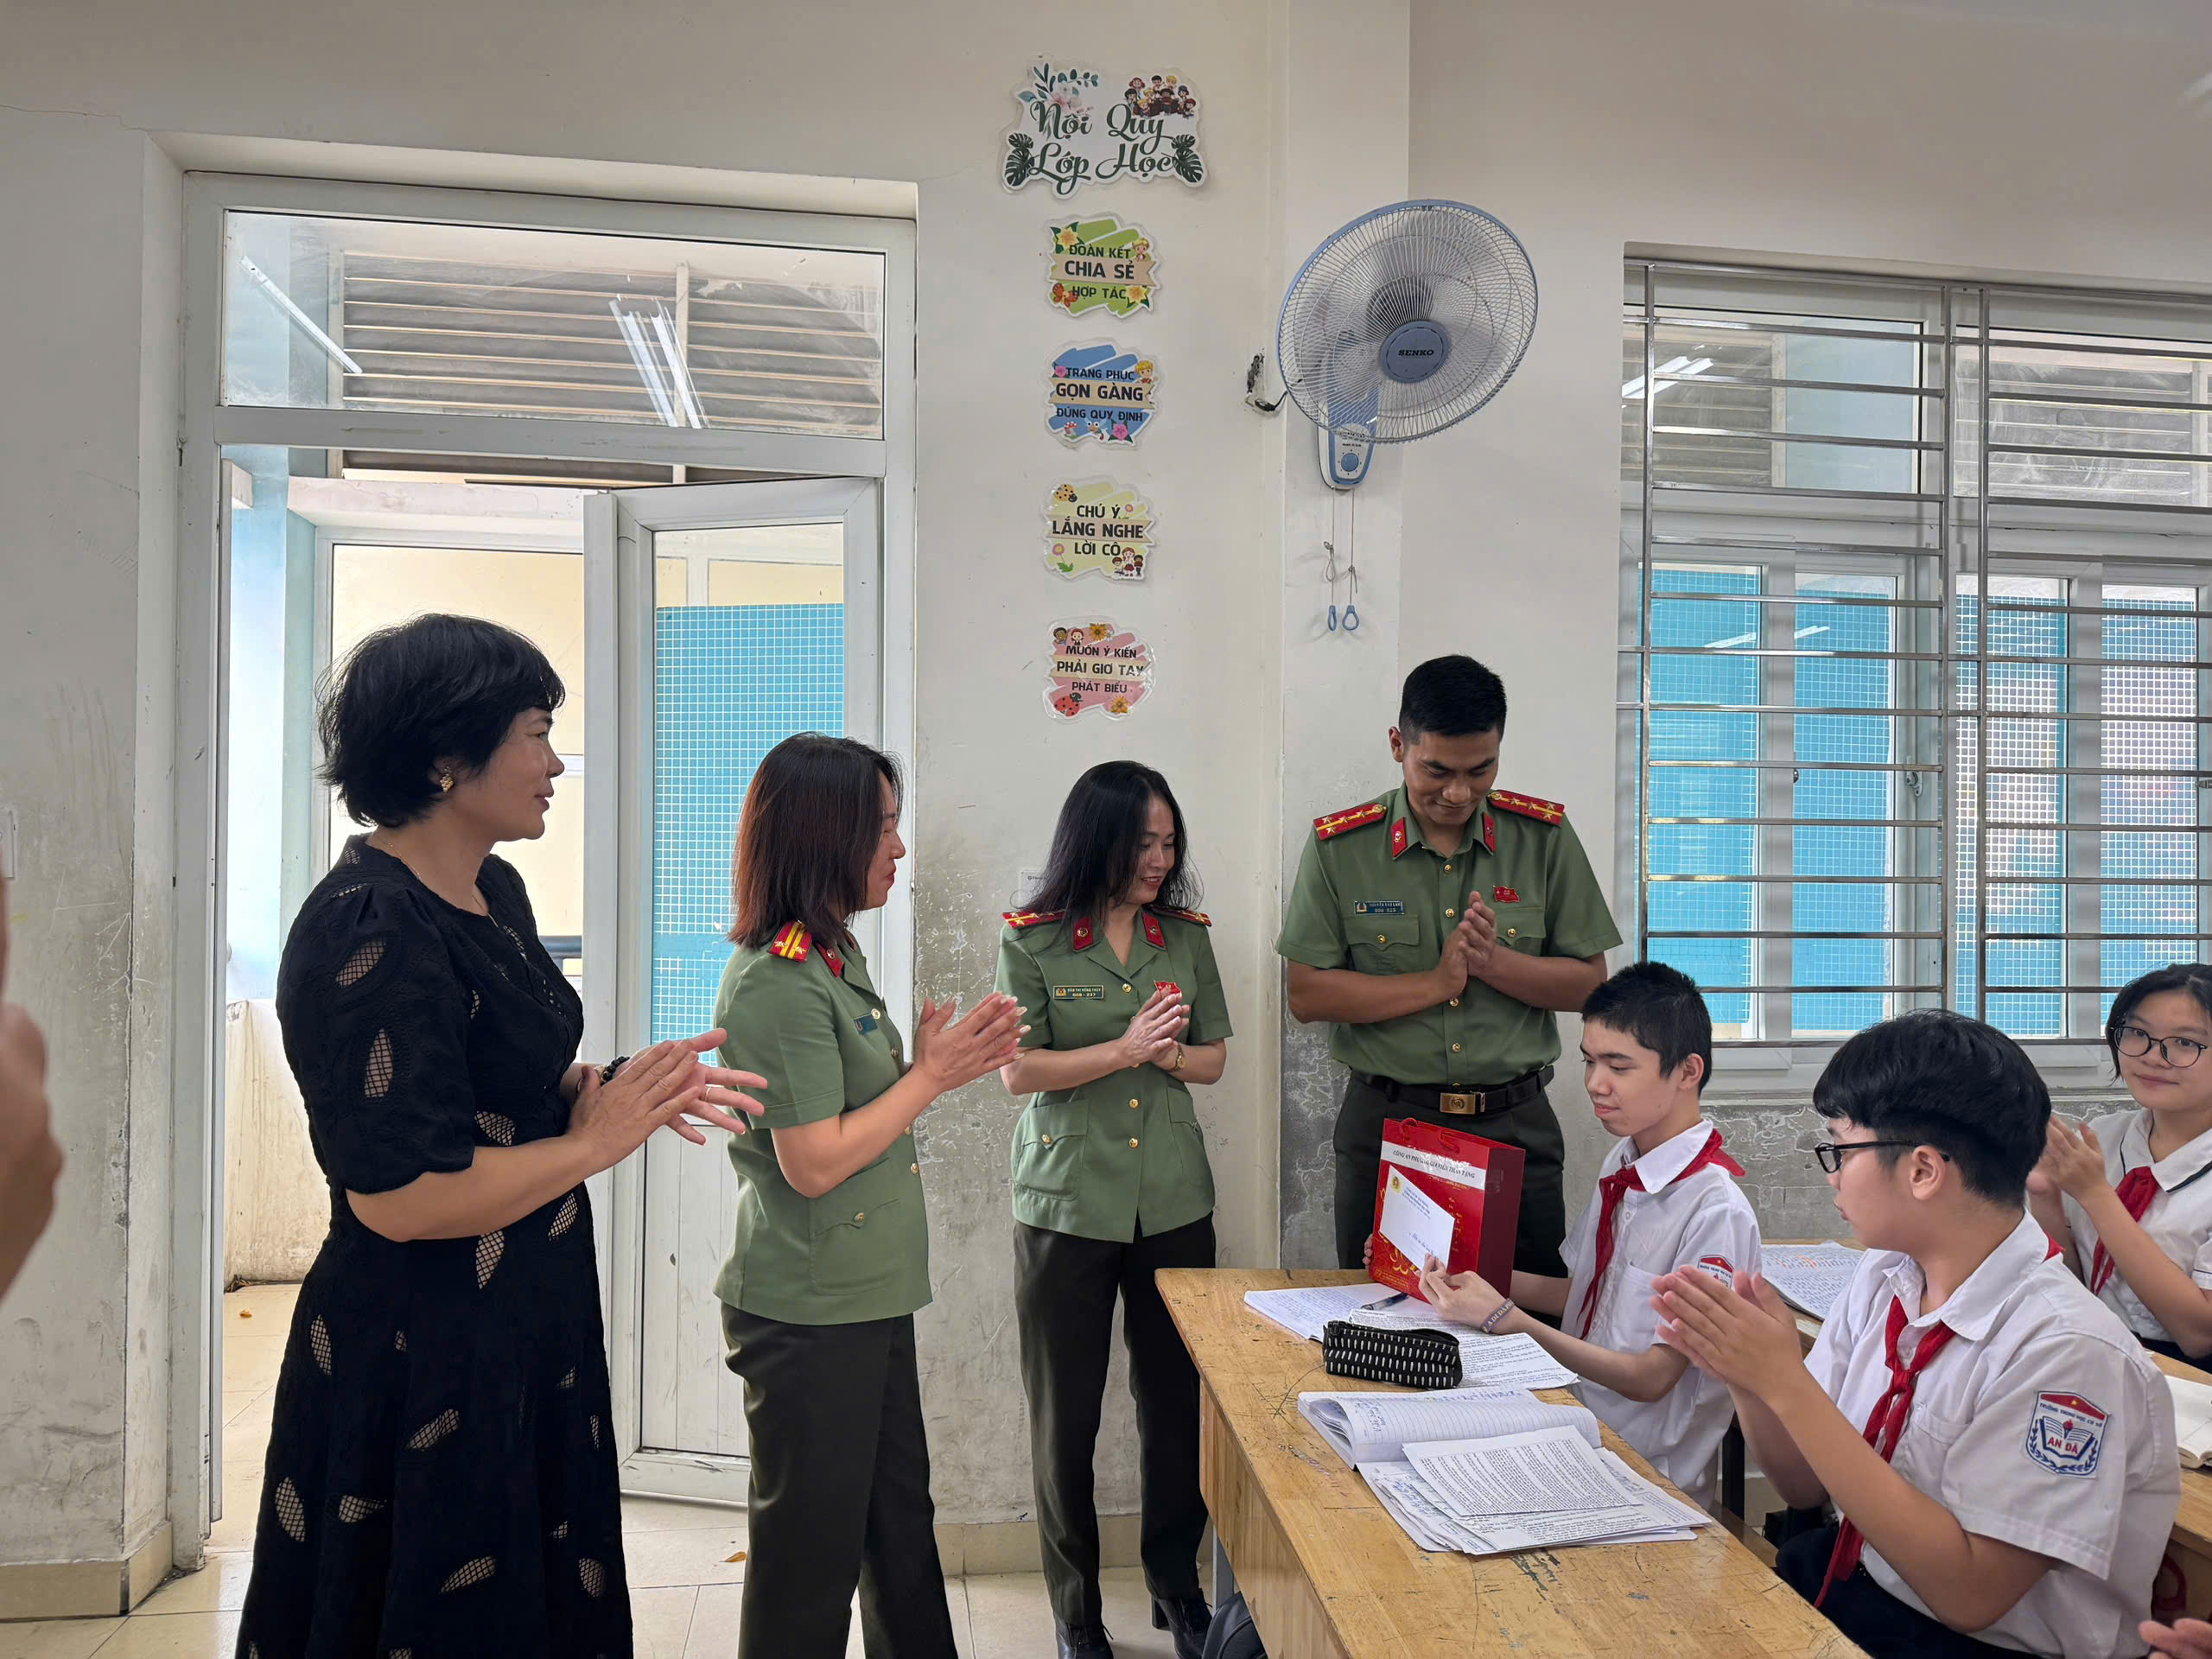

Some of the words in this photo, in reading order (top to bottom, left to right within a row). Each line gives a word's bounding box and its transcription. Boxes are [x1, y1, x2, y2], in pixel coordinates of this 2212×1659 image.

[1030, 101, 1092, 139] Nội
[1106, 104, 1173, 155] Quy
[1028, 143, 1091, 194] Lớp
[1096, 143, 1174, 178] Học
[1069, 244, 1104, 257] ĐOÀN
[1109, 245, 1131, 258] KẾT
[1065, 260, 1106, 277] CHIA
[1114, 260, 1135, 279] SẺ
[1072, 286, 1096, 300] HỢP
[1102, 286, 1127, 299] TÁC
[1066, 367, 1102, 378] TRANG
[1056, 383, 1090, 401] GỌN
[1097, 382, 1143, 401] GÀNG
[1056, 406, 1086, 418] ĐÚNG
[1090, 410, 1113, 420] QUY
[1077, 503, 1105, 518] CHÚ
[1111, 504, 1121, 518] Ý
[1052, 516, 1096, 537] LẮNG
[1102, 524, 1143, 538] NGHE
[1074, 540, 1096, 555] LỜI
[1102, 542, 1121, 556] CÔ
[1065, 644, 1099, 656] MUỐN
[1103, 645, 1110, 656] Ý
[1114, 646, 1137, 658] KIẾN
[1057, 658, 1087, 673] PHẢI
[1092, 663, 1113, 675] GIƠ
[1118, 664, 1144, 676] TAY
[1071, 680, 1100, 692] PHÁT
[1104, 681, 1128, 693] BIỂU
[2048, 1437, 2063, 1449] AN
